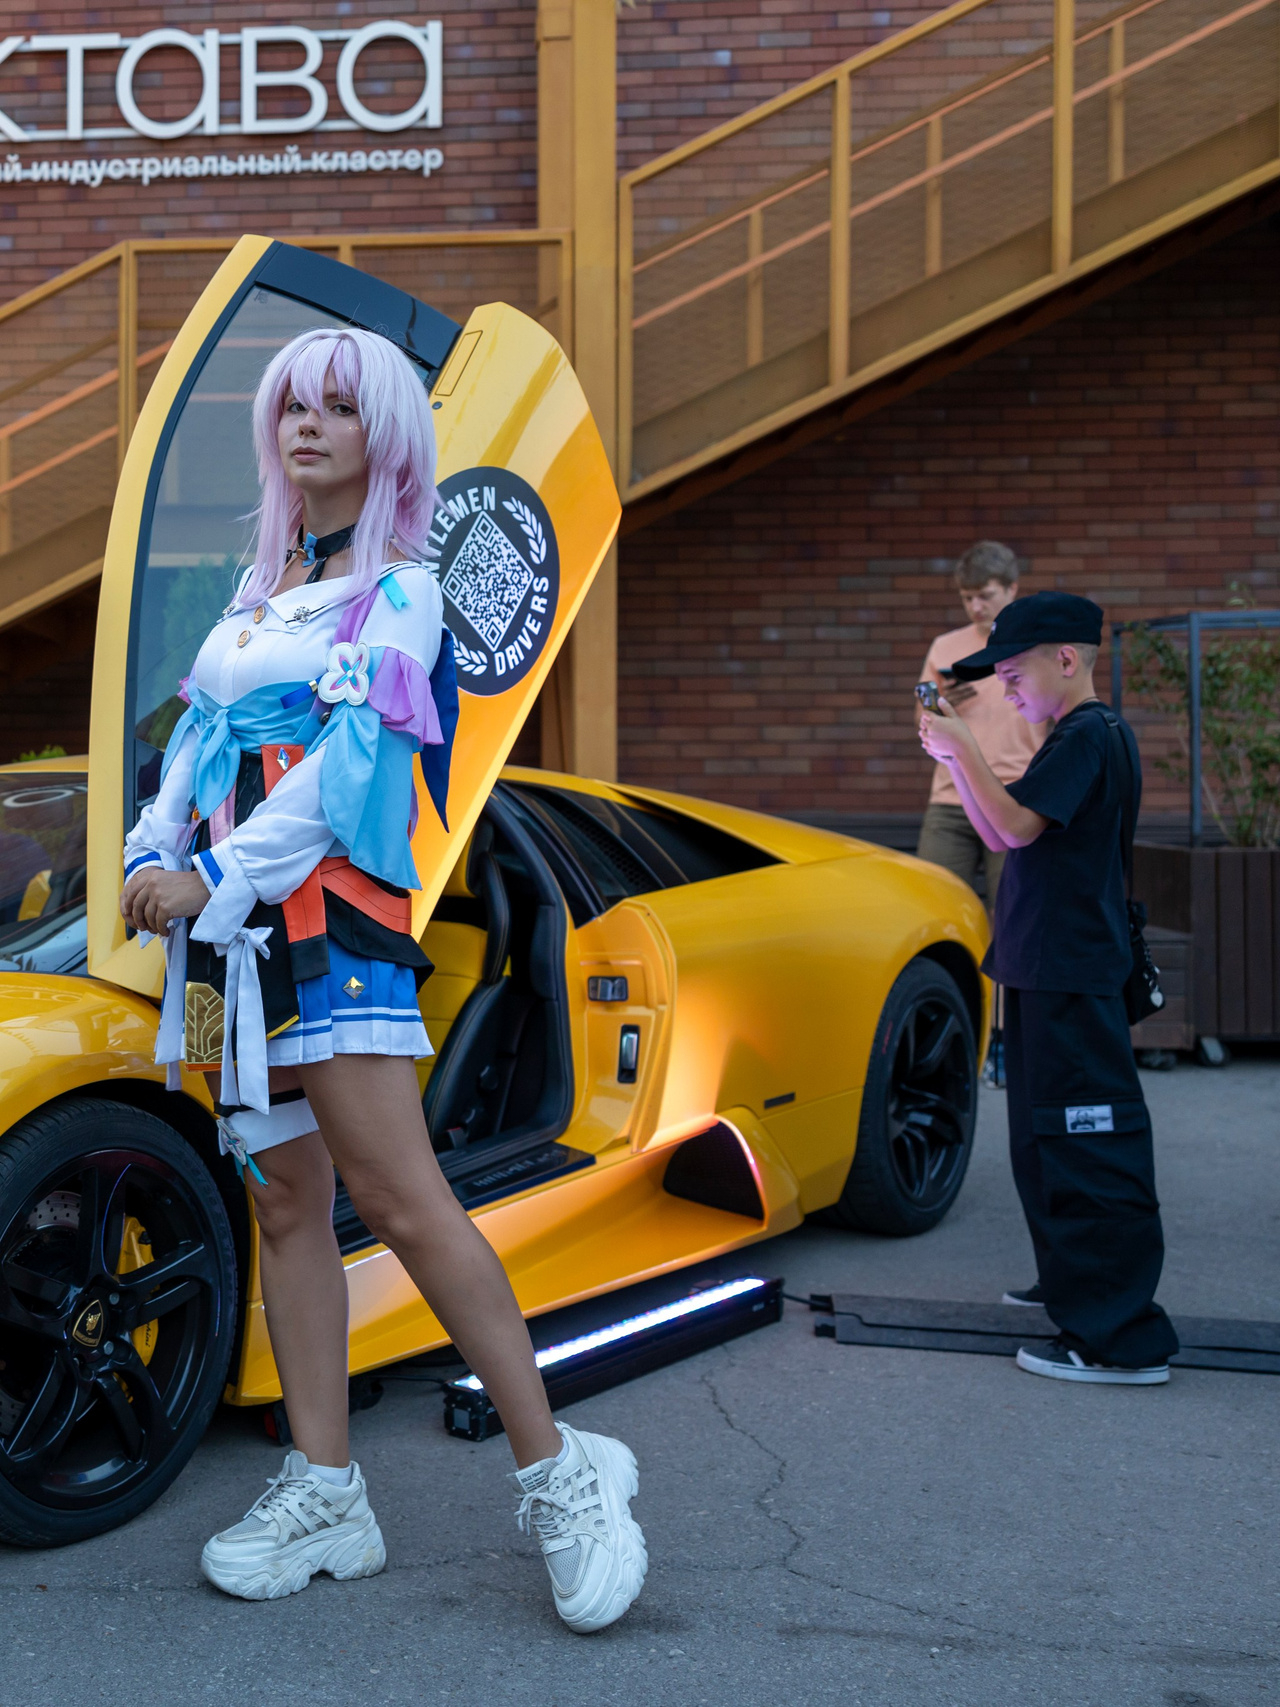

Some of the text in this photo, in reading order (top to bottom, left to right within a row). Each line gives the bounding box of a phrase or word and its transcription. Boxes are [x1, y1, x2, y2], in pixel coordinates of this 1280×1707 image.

[31, 144, 301, 188] индустриальный
[311, 147, 444, 178] кластер
[494, 577, 549, 676] DRIVERS
